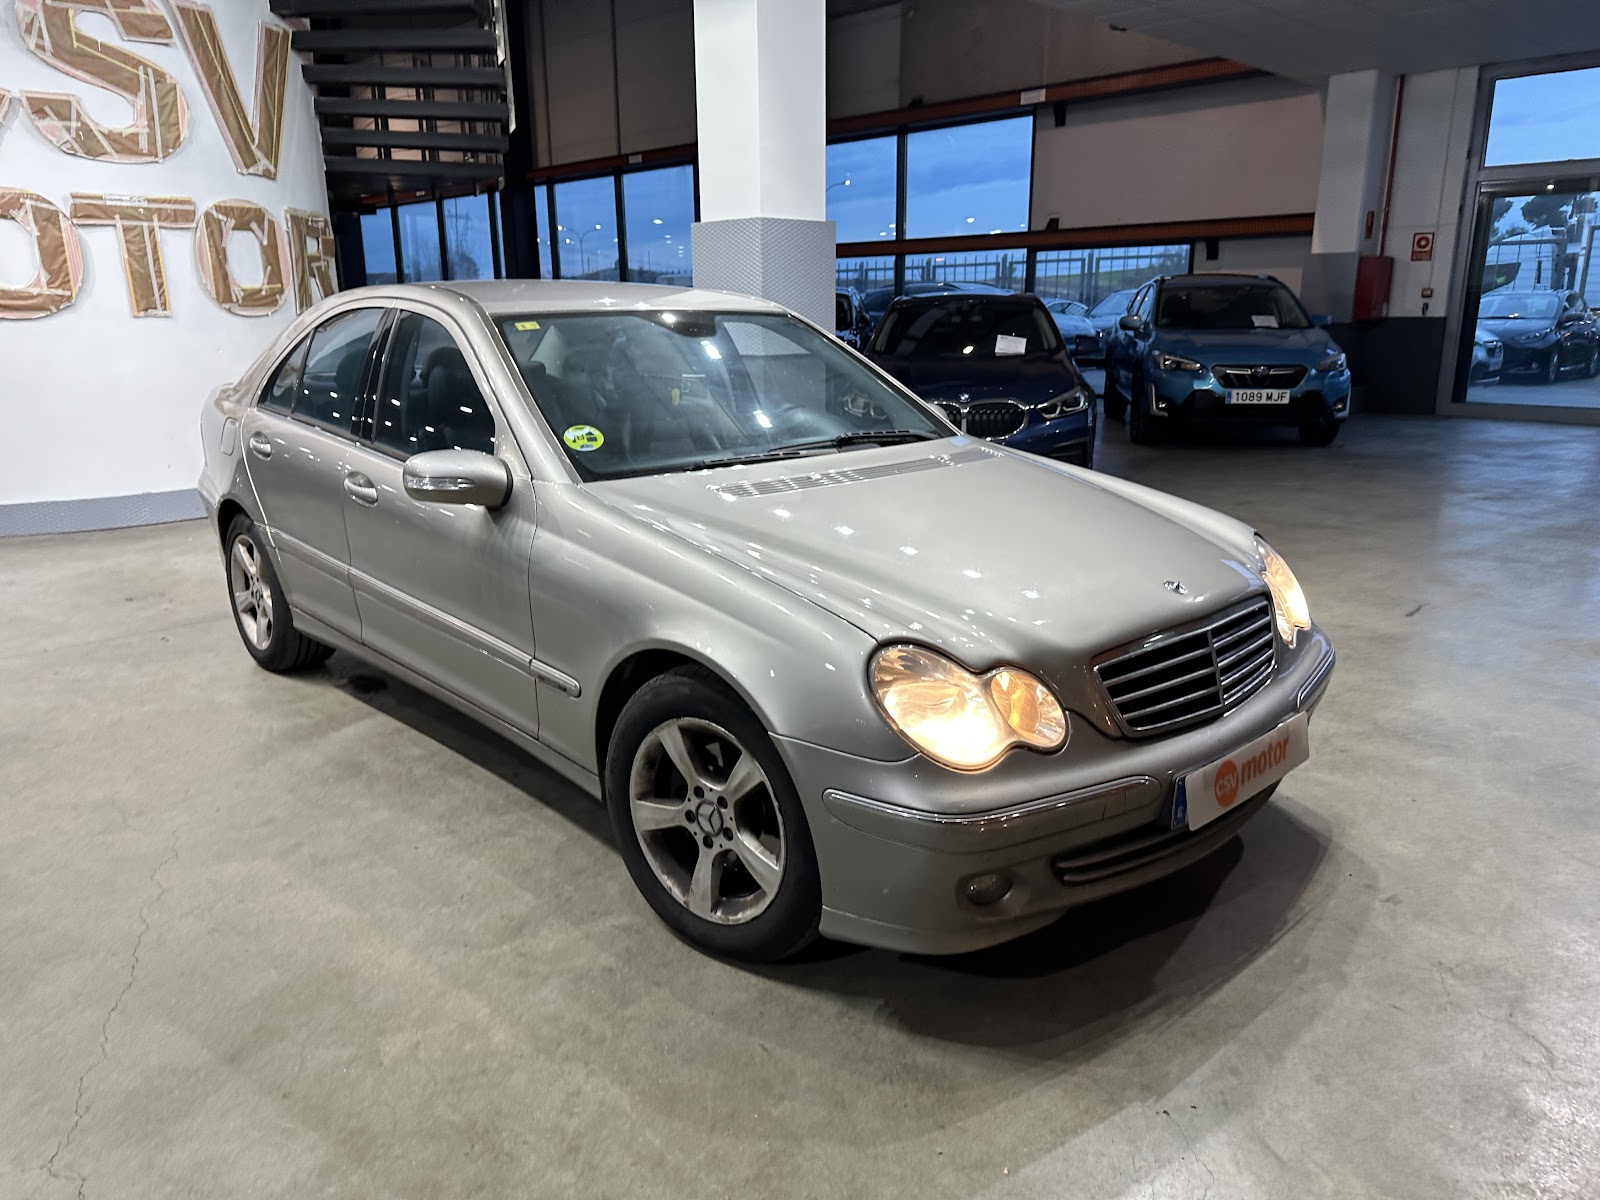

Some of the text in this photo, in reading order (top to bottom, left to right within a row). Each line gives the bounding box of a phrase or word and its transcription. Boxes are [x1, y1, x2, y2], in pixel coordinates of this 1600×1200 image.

[1235, 391, 1288, 402] 1089 MJF
[1240, 735, 1289, 785] motor
